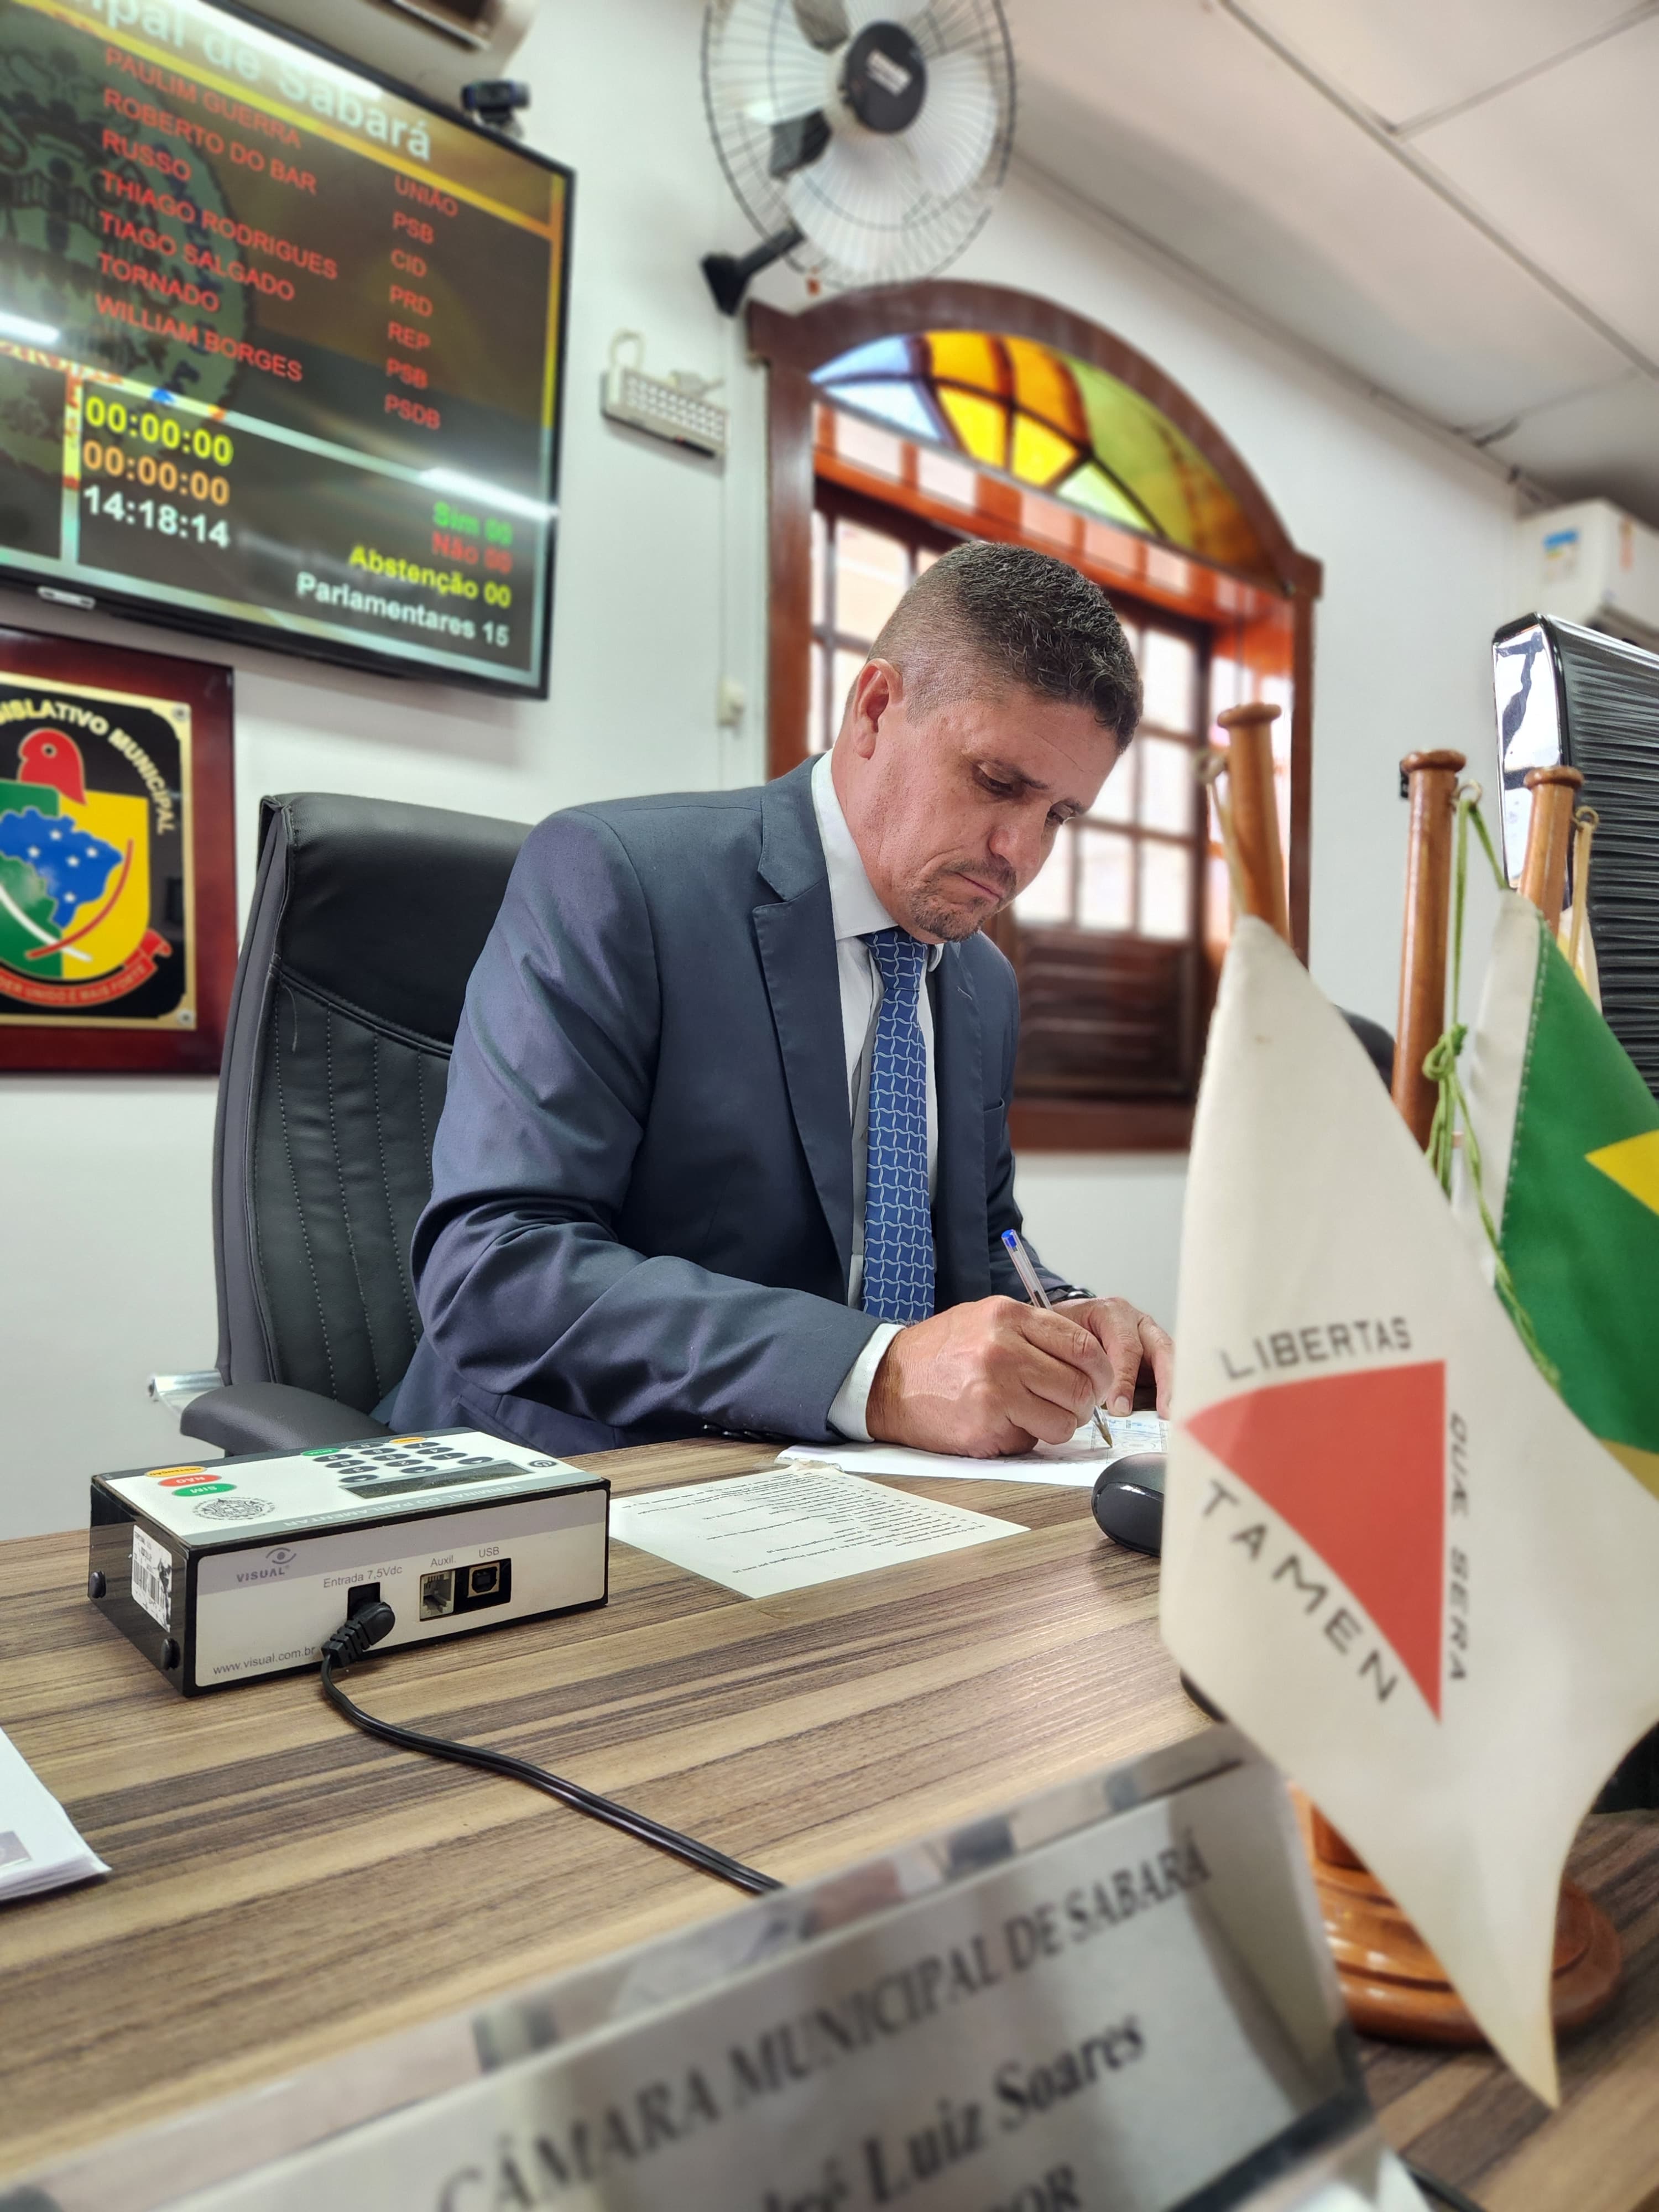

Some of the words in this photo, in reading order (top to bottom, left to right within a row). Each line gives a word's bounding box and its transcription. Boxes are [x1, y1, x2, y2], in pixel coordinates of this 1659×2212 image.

[106, 46, 197, 104] PAULIM
[202, 90, 301, 150] GUERRA
[203, 29, 261, 80] de
[278, 56, 431, 161] Sabará
[102, 128, 192, 181] RUSSO
[103, 87, 225, 154] ROBERTO
[231, 141, 265, 171] DO
[270, 158, 317, 196] BAR
[394, 174, 458, 217] UNIÃO
[101, 169, 196, 223] THIAGO
[201, 210, 338, 280] RODRIGUES
[393, 211, 435, 244] PSB
[98, 252, 220, 312] TORNADO
[99, 210, 177, 257] TIAGO
[183, 243, 296, 301] SALGADO
[390, 248, 427, 278] CID
[389, 284, 433, 318] PRD
[96, 293, 199, 347] WILLIAM
[204, 330, 304, 382] BORGES
[388, 321, 431, 351] REP
[387, 357, 429, 389] PSB
[86, 395, 234, 467] 00:00:00
[384, 393, 441, 431] PSDB
[83, 439, 231, 507] 00:00:00
[84, 484, 231, 549] 14:18:14
[432, 500, 481, 536] Sim
[484, 518, 514, 546] 00
[348, 544, 479, 601] Abstenção
[483, 580, 512, 609] 00
[431, 530, 479, 565] Não
[483, 545, 514, 575] 00
[296, 570, 477, 640] Parlamentares
[483, 620, 510, 648] 15
[0, 698, 109, 735] ISLATIVO
[108, 728, 175, 835] MUNICIPAL
[1218, 1317, 1412, 1381] LIBERTAS
[175, 1476, 206, 1484] NÃO
[190, 1485, 218, 1494] SIM
[447, 1484, 523, 1499] TERMINAL
[284, 1501, 414, 1527] PARLAMENTAR
[323, 1573, 364, 1589] Entrada
[367, 1565, 403, 1580] 7,5Vdc
[430, 1554, 456, 1568] Auxil.
[478, 1546, 500, 1559] USB
[1201, 1478, 1399, 1704] TAMEN
[1449, 1545, 1469, 1681] SERA
[212, 1645, 316, 1676] www.visual.com.br
[437, 2065, 721, 2212] CÂMARA
[724, 1932, 1002, 2101] MUNICIPAL
[1004, 1901, 1065, 1973] DE
[1063, 1825, 1212, 1945] SABARÁ
[864, 2097, 989, 2209] Luiz
[994, 2013, 1147, 2133] Soares
